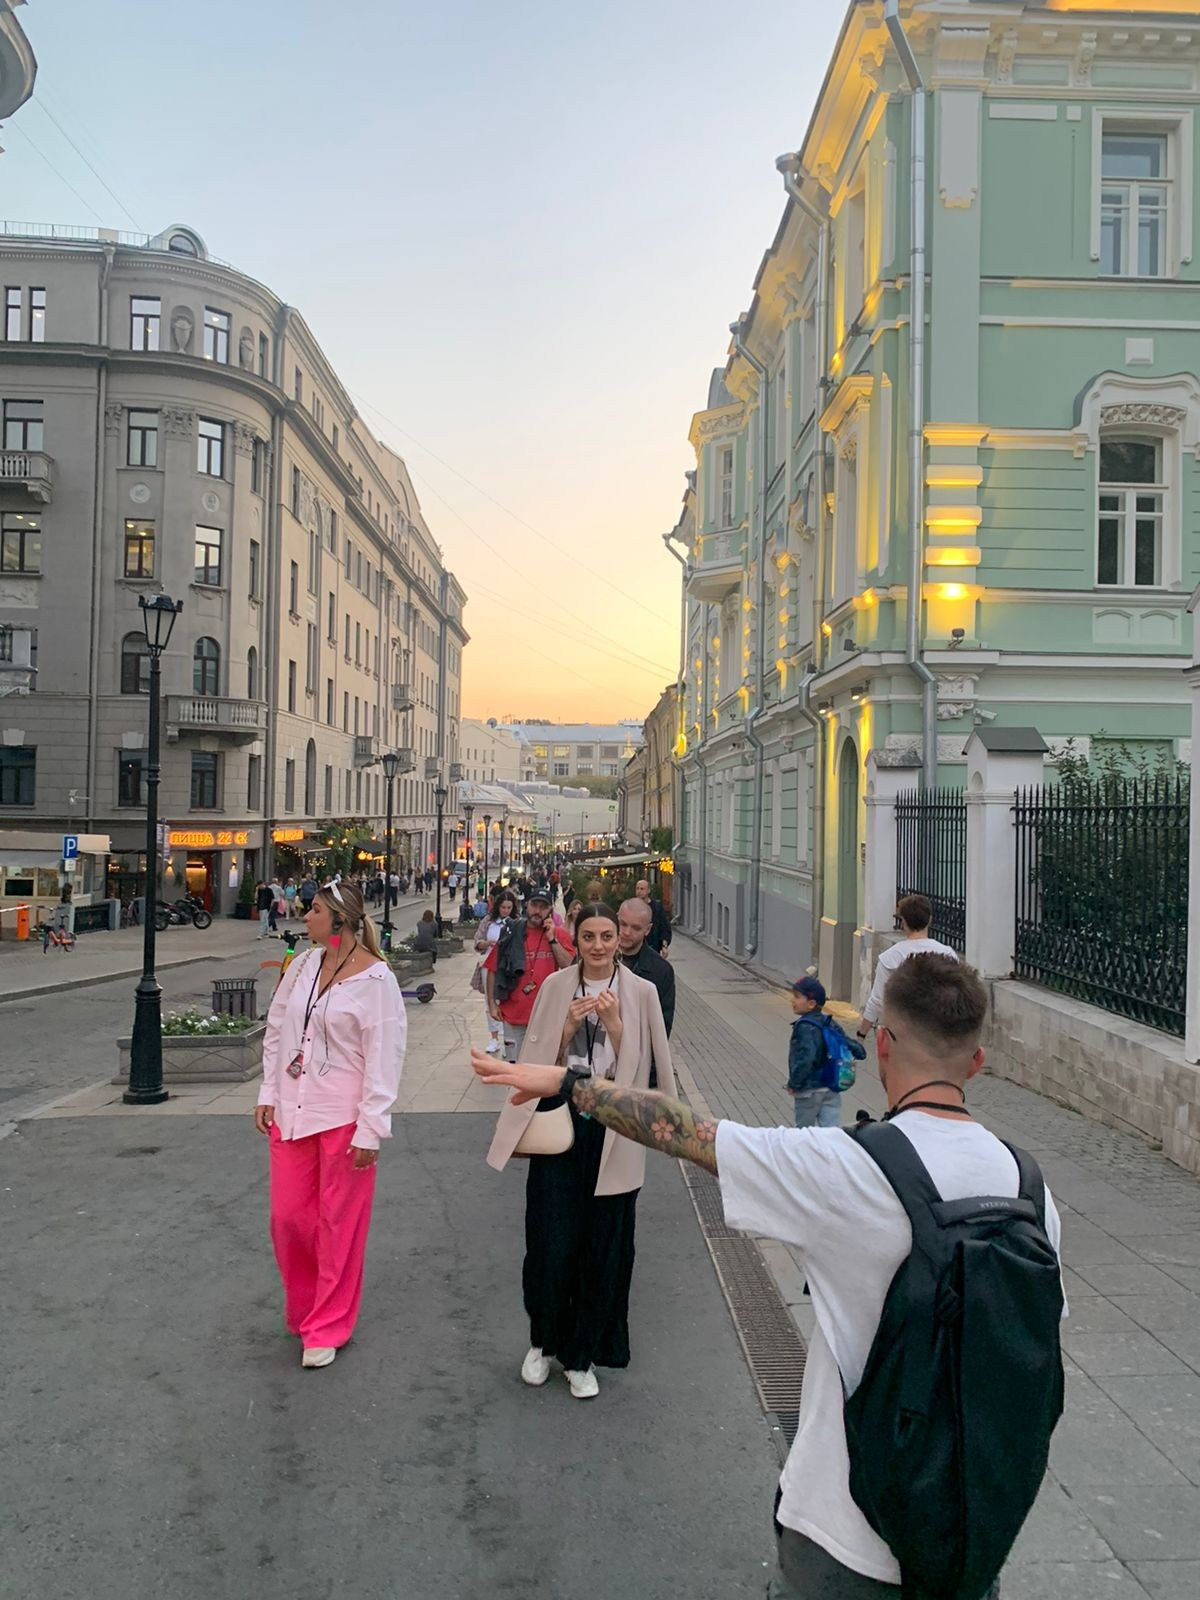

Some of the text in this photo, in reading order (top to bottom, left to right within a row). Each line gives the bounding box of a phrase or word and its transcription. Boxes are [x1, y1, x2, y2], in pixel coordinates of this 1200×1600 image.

[170, 831, 214, 846] ПИЦЦА
[217, 831, 232, 845] 22
[66, 838, 76, 856] P
